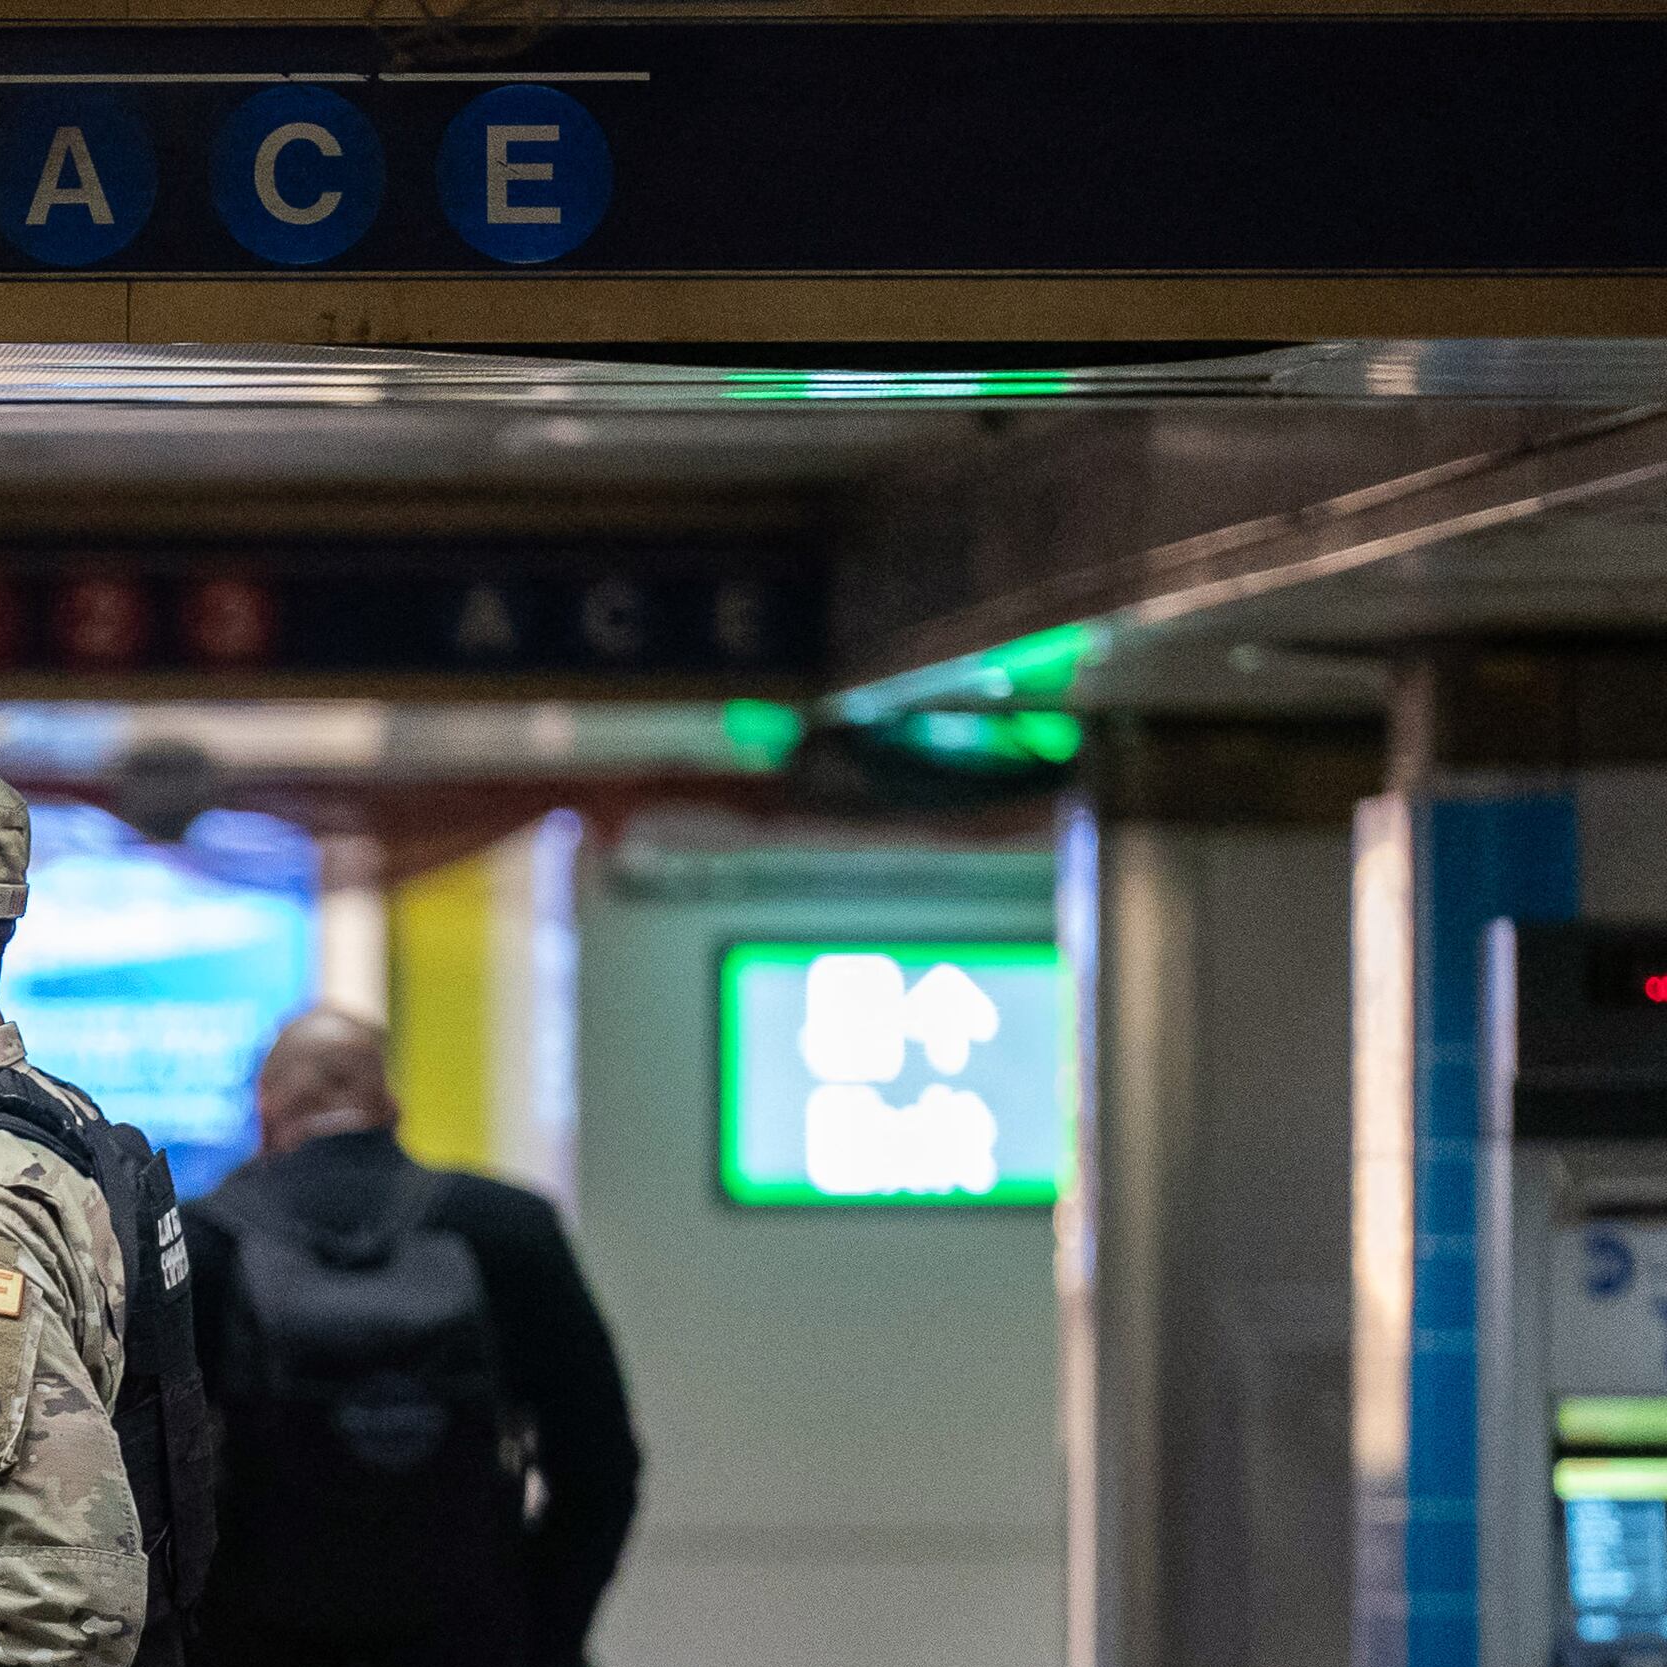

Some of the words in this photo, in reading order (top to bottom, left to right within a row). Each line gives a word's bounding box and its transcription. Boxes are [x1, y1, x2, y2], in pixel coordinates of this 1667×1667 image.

[27, 126, 113, 225] A
[254, 122, 341, 225] C
[486, 125, 561, 224] E
[454, 582, 515, 652] A
[581, 577, 644, 654] C
